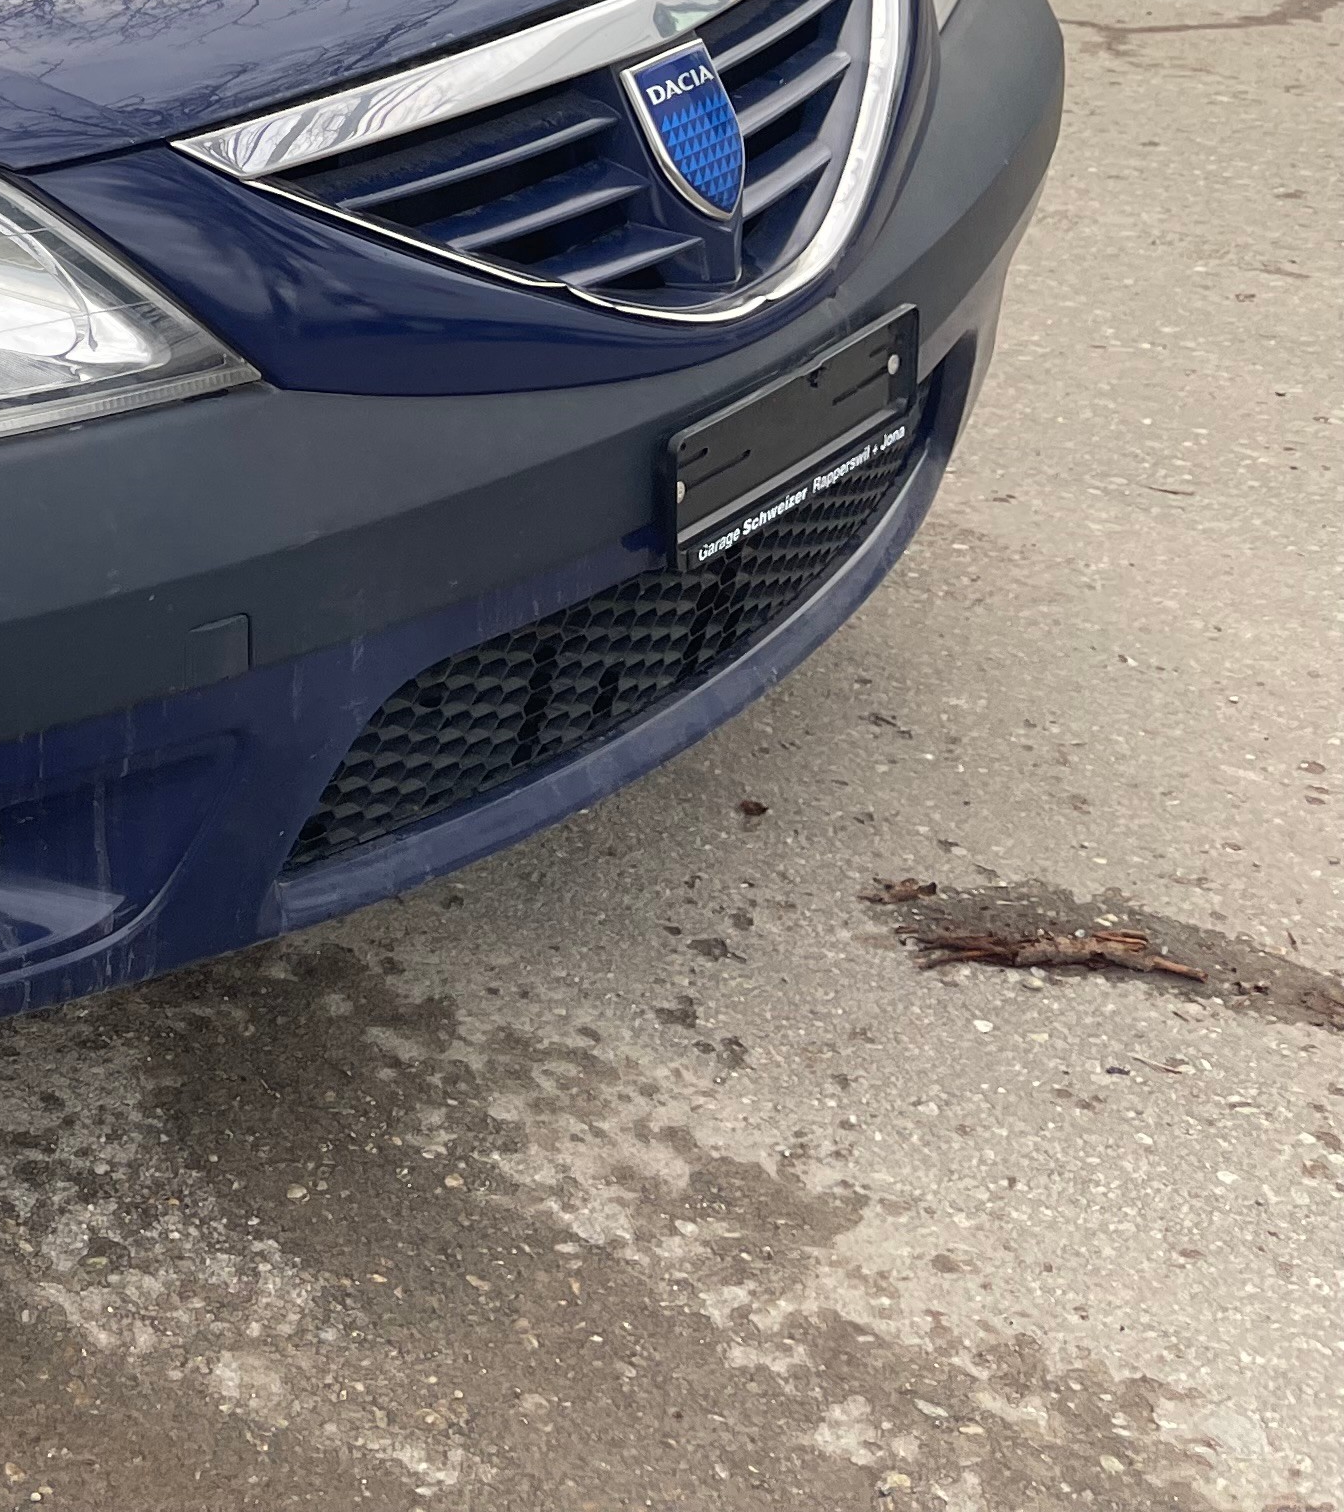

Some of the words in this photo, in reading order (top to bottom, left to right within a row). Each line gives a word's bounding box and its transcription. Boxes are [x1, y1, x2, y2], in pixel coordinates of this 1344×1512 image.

[646, 64, 715, 106] DACIA
[698, 527, 741, 562] Garage
[742, 487, 808, 536] Schweizer
[812, 444, 871, 494] Rapperswil
[879, 425, 906, 451] Jona
